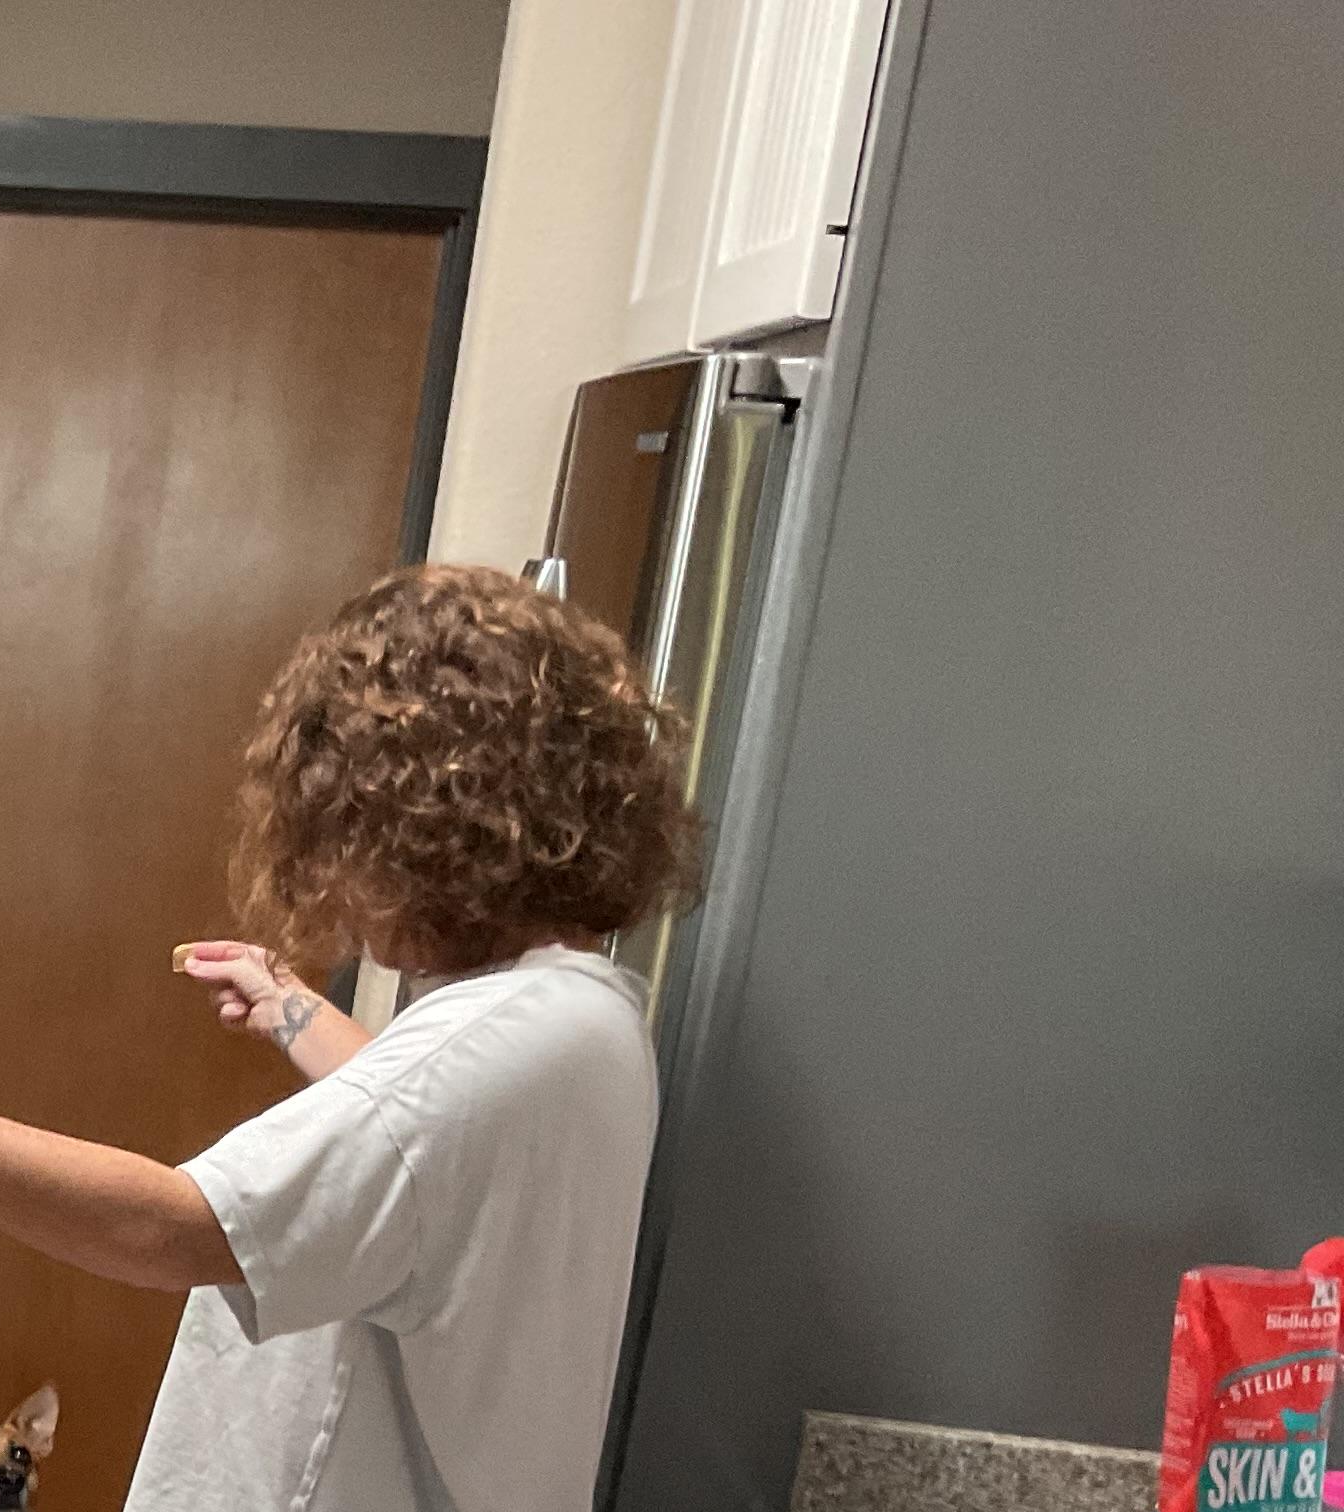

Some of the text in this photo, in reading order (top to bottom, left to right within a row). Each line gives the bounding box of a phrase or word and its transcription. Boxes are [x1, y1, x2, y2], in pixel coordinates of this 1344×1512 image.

[1229, 1363, 1311, 1403] STELLA'S
[1207, 1448, 1317, 1509] SKIN &
